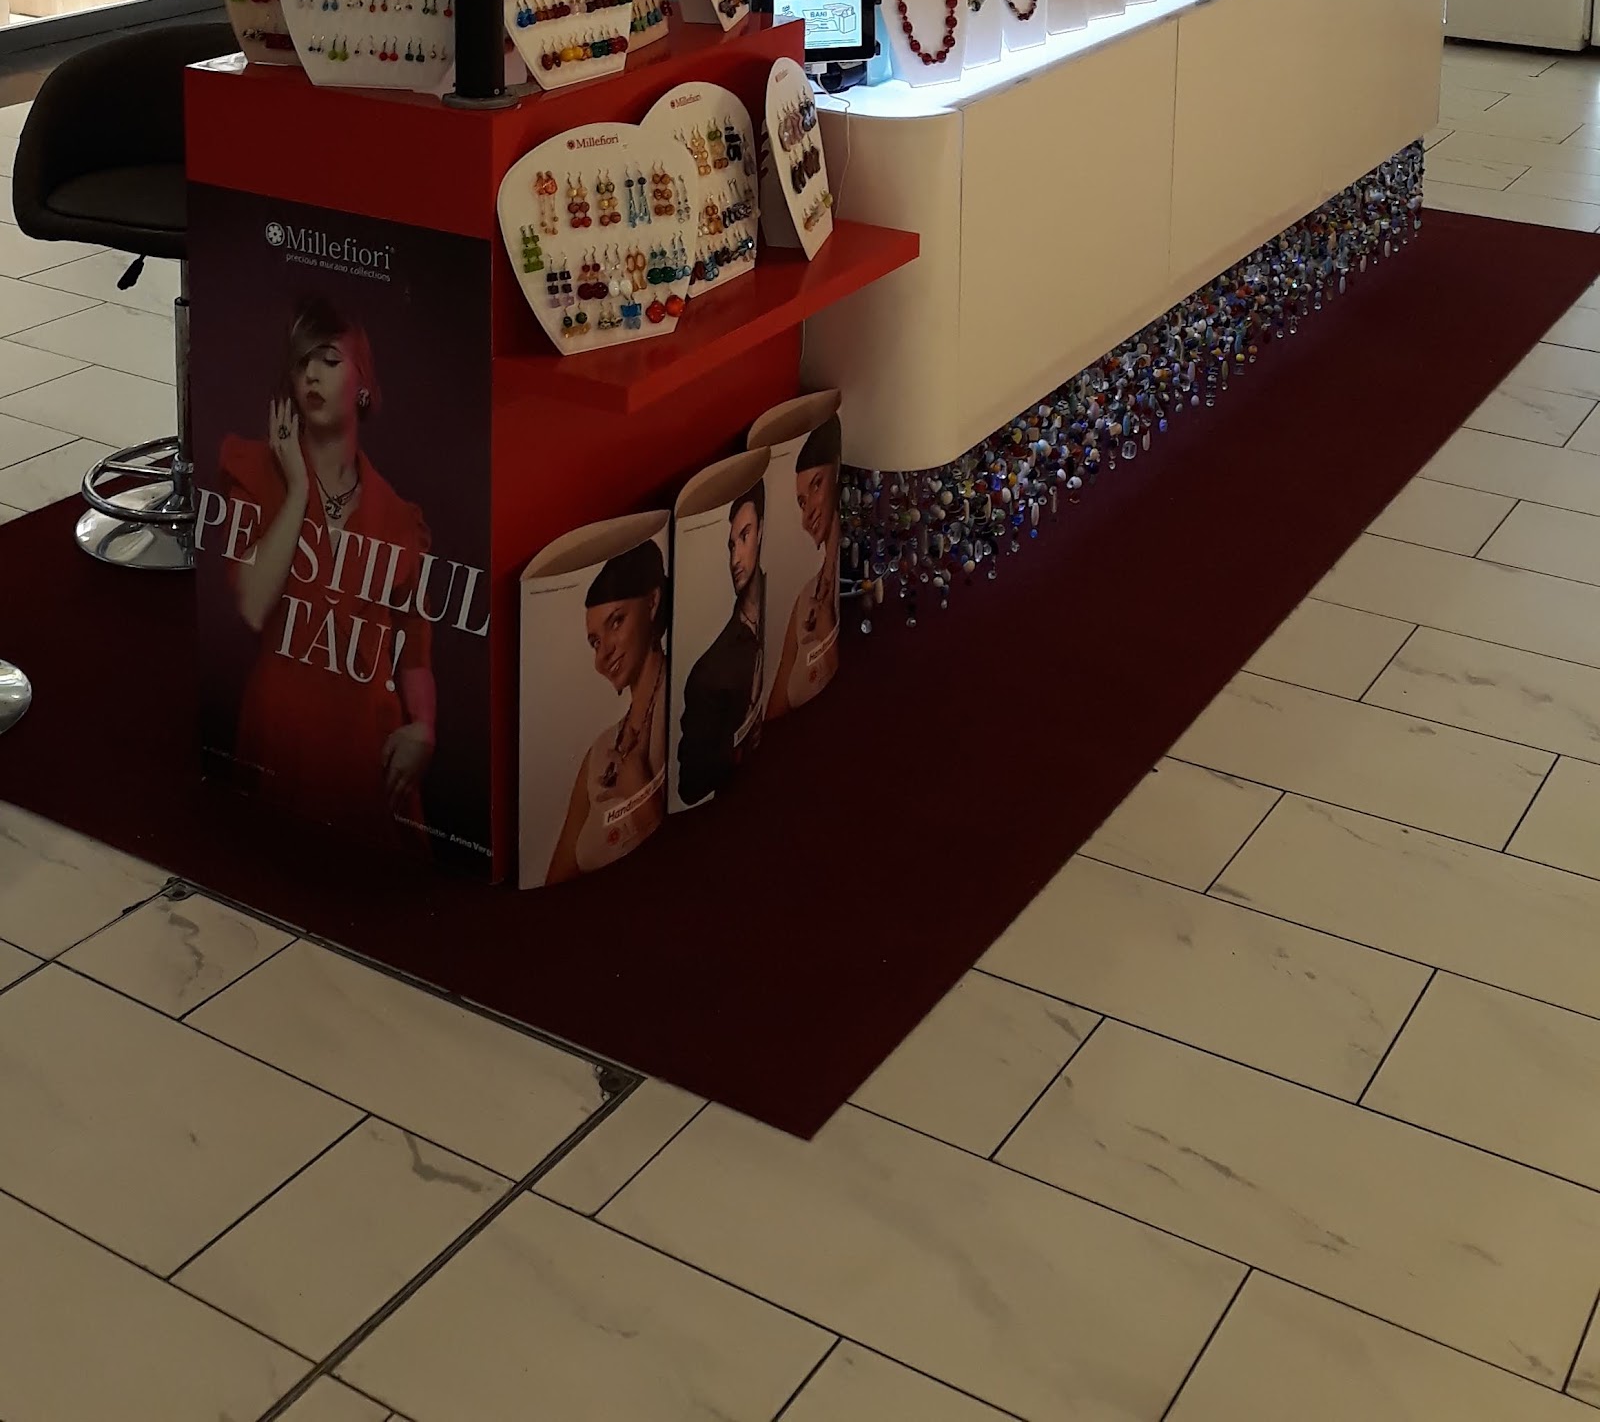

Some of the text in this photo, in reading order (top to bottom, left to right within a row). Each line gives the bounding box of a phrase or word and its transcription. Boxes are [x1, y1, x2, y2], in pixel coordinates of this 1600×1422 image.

[575, 133, 619, 150] Millefiori
[286, 225, 391, 270] Millefiori
[286, 253, 318, 266] precious
[350, 266, 391, 282] collections
[194, 487, 491, 638] PE STILUL
[274, 593, 406, 692] TĂU!
